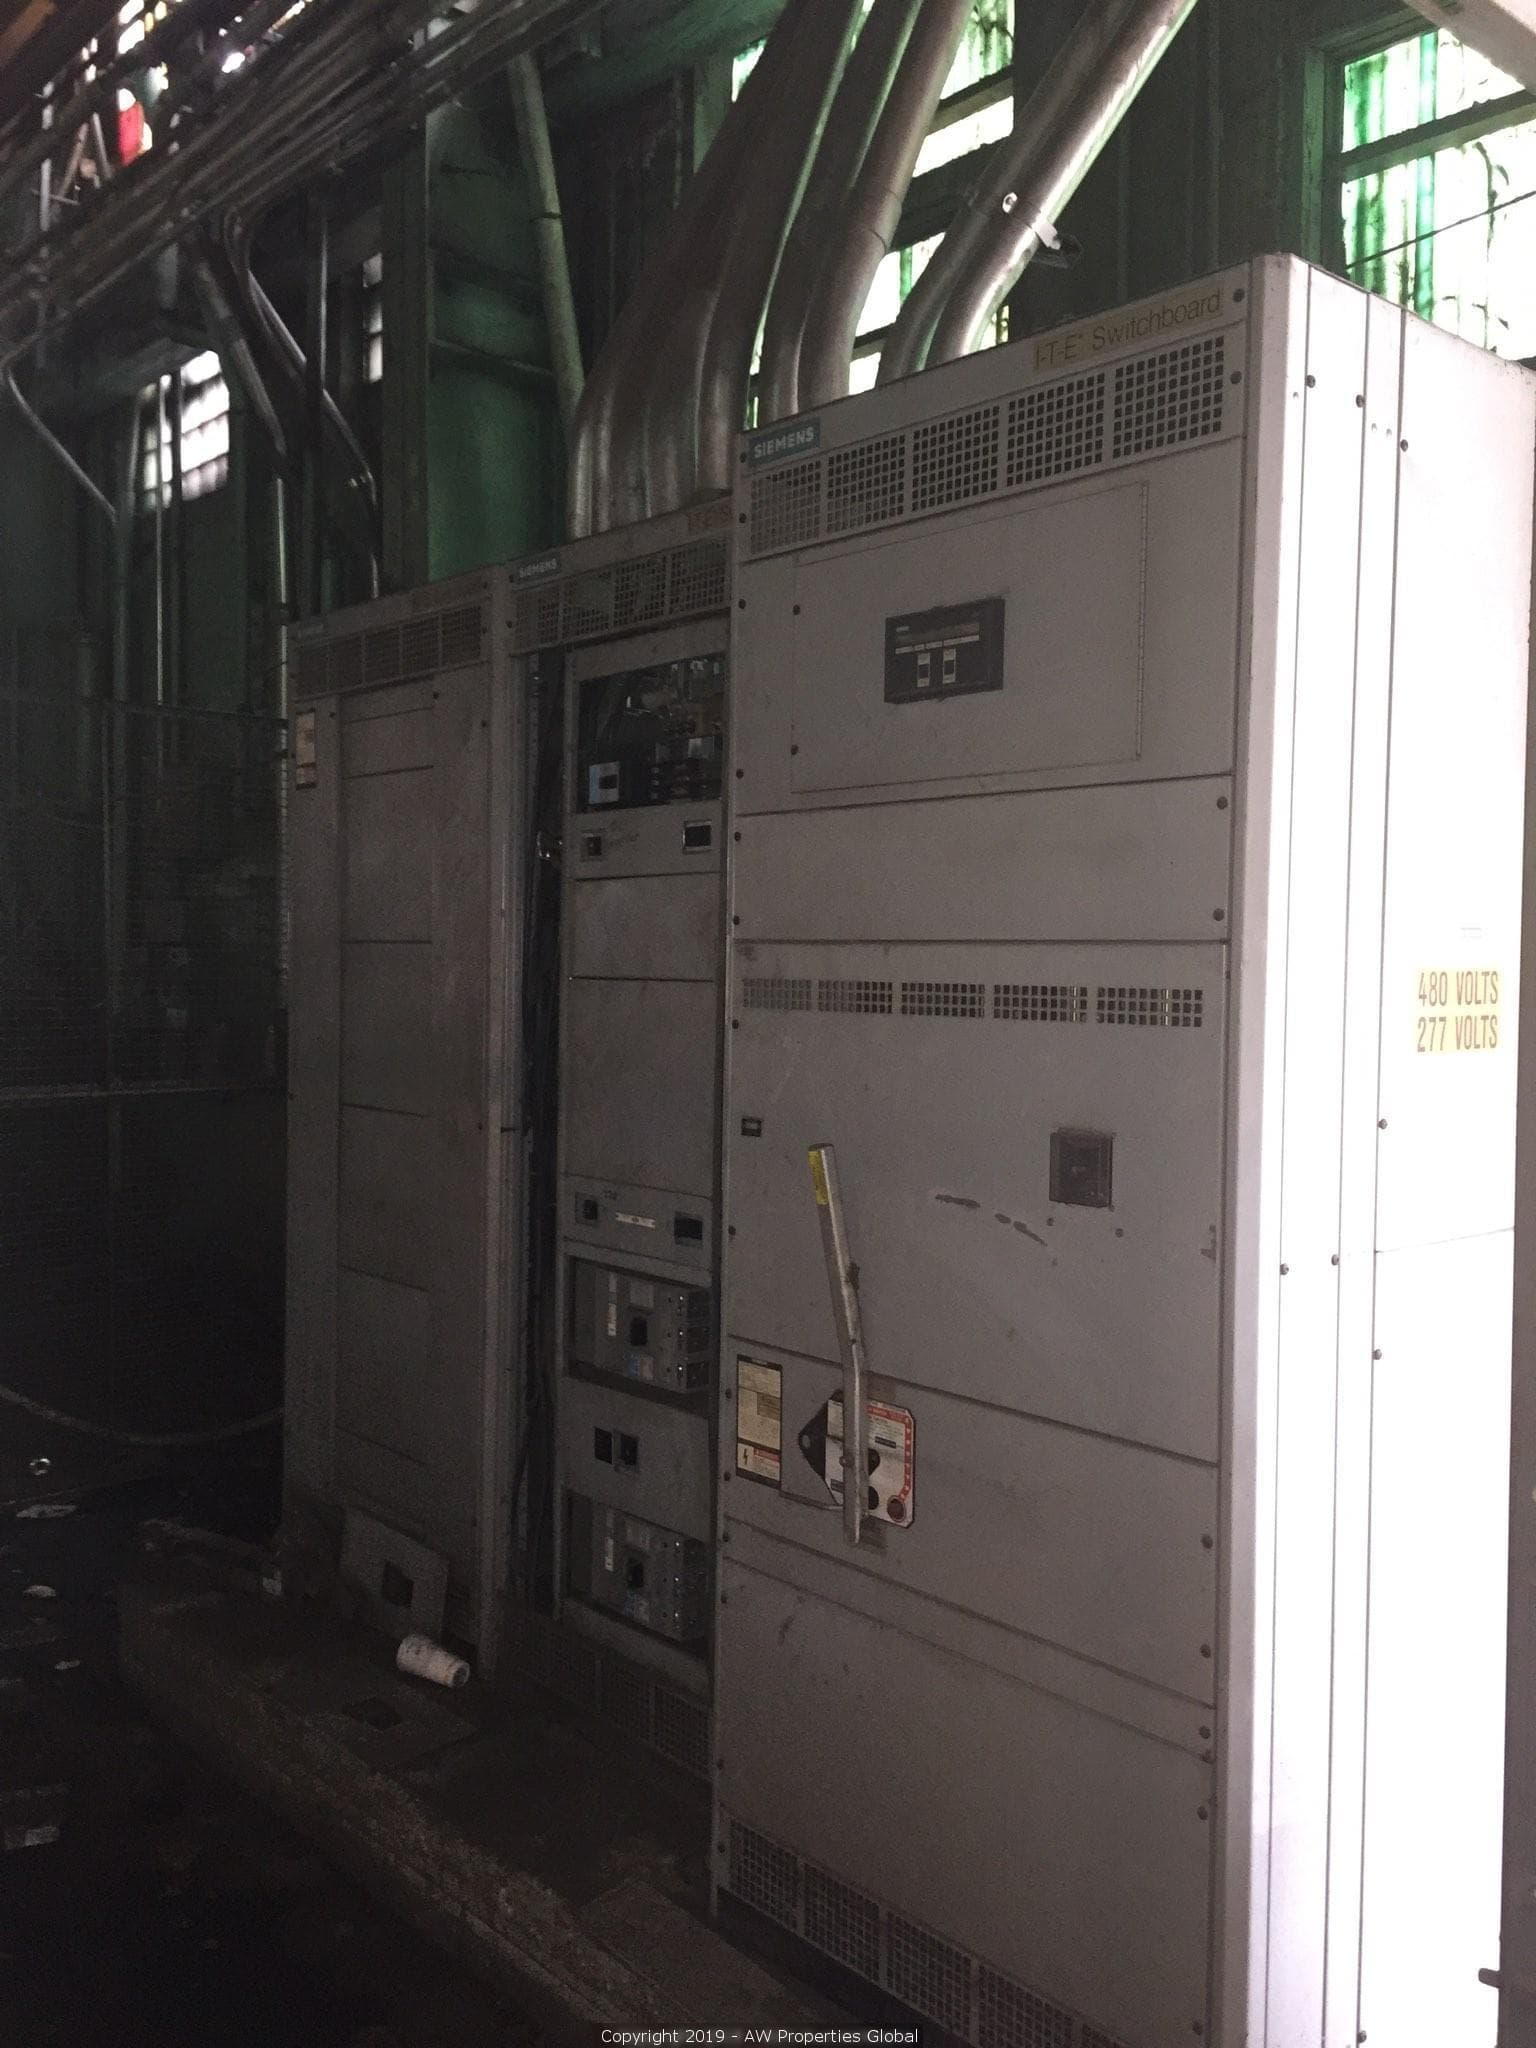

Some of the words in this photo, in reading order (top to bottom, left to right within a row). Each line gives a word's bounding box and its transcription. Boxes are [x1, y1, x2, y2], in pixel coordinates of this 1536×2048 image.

[1092, 288, 1222, 351] Switchboard
[752, 425, 817, 459] SIEMENS
[1418, 971, 1448, 1007] 480
[1456, 970, 1499, 1006] VOLTS
[1417, 1015, 1447, 1052] 277
[1455, 1014, 1498, 1050] VOLTS
